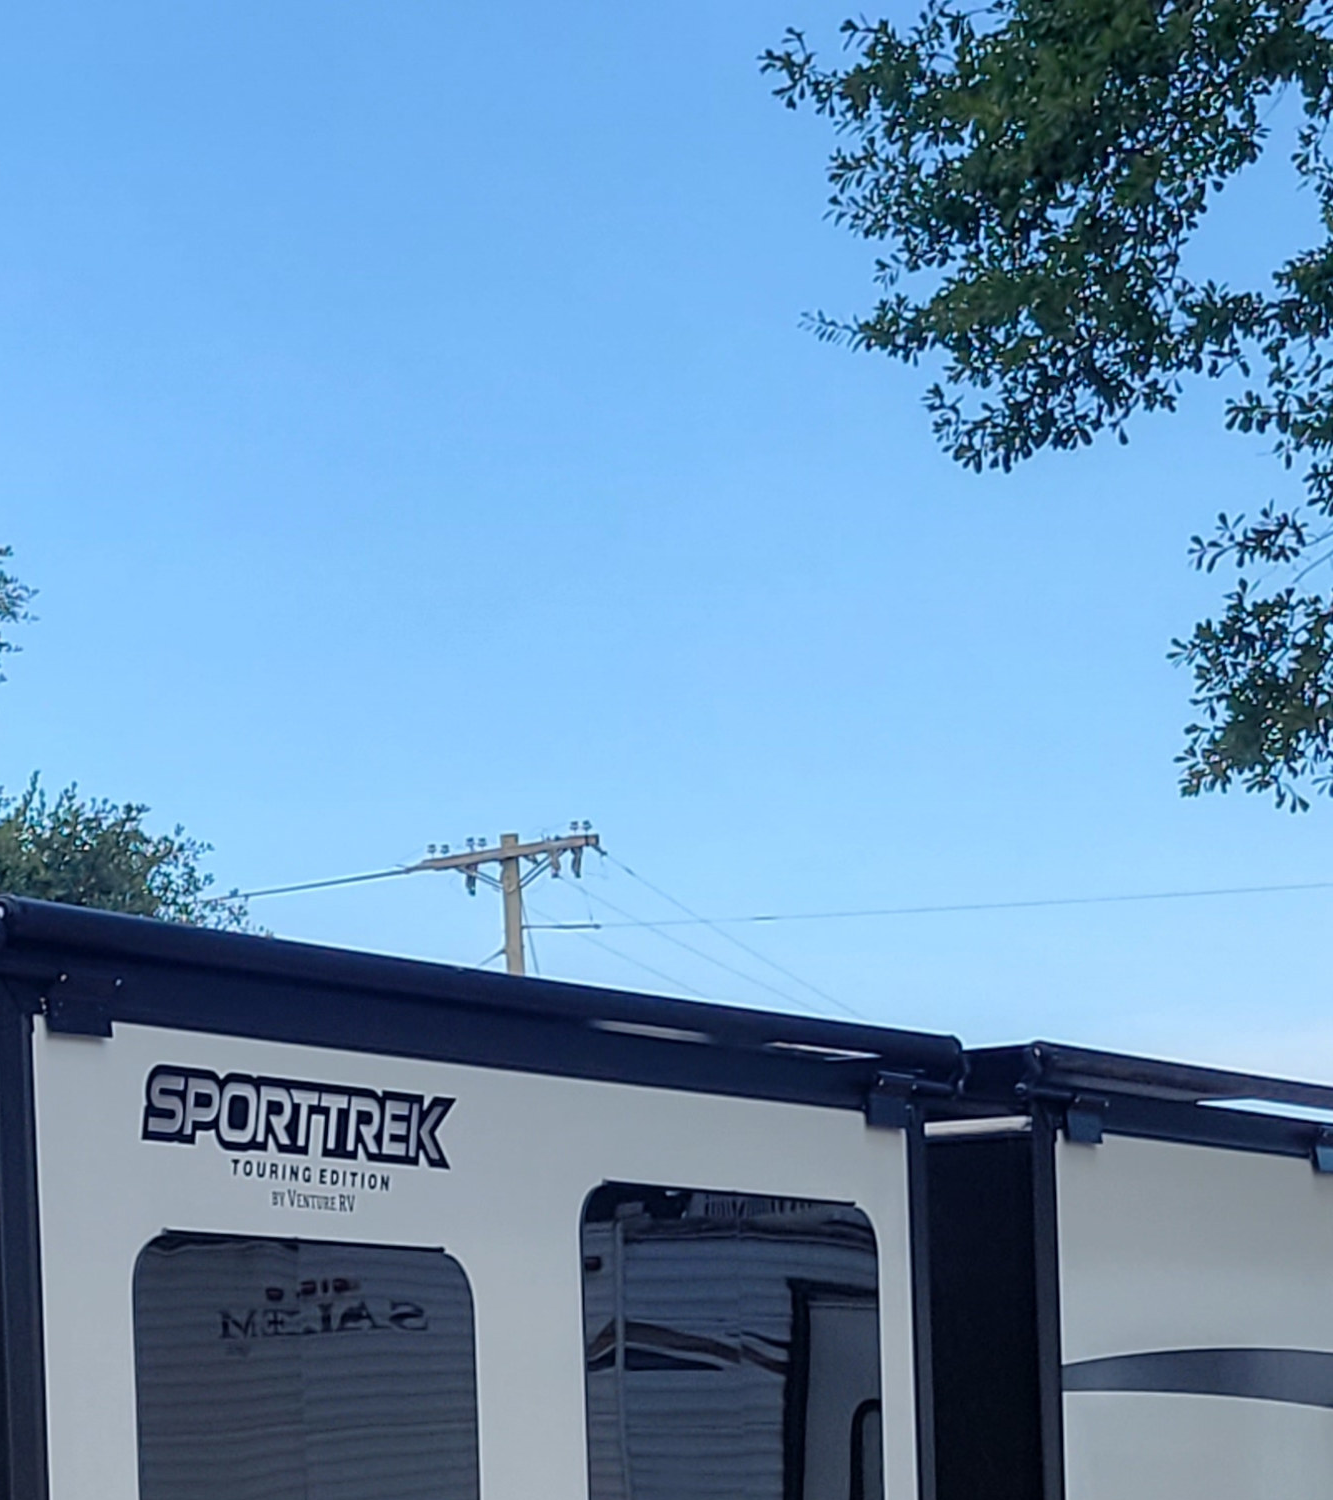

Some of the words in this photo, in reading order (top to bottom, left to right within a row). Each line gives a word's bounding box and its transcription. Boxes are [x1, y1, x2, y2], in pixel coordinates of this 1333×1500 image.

[142, 1064, 455, 1169] SPORTTREK
[231, 1158, 312, 1183] TOURING
[319, 1168, 390, 1191] EDITION
[339, 1193, 355, 1212] RV
